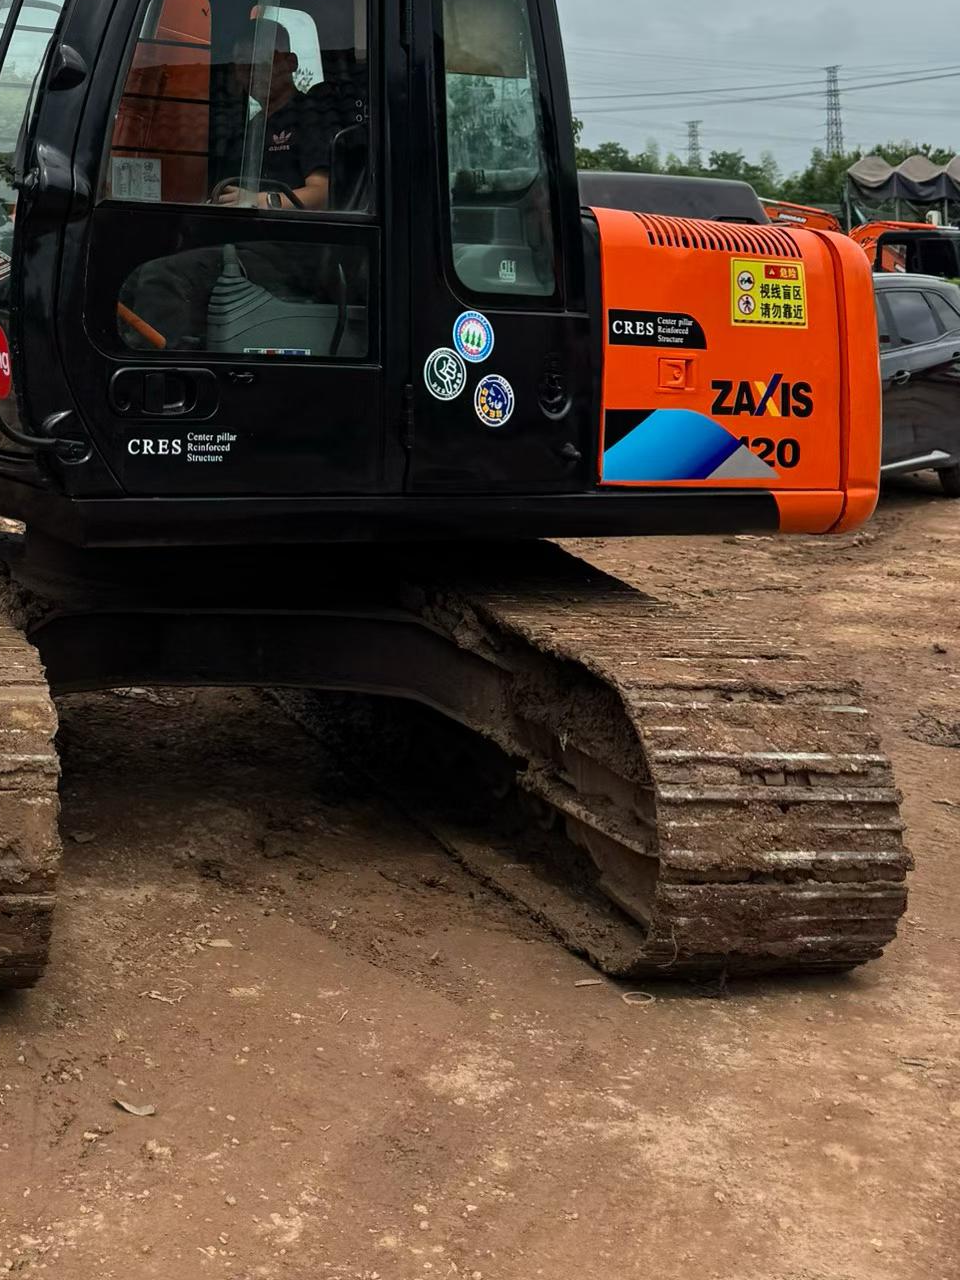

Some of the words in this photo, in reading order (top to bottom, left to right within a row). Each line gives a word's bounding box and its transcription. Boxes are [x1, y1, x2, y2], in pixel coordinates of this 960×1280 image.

[760, 283, 802, 301] 视线盲区
[760, 303, 803, 320] 请勿靠近
[612, 320, 654, 335] CRES
[657, 317, 676, 325] Center
[678, 319, 693, 327] pillar
[657, 325, 689, 335] Reinforced
[657, 334, 684, 343] Structure
[711, 373, 814, 418] ZAXIS
[187, 432, 214, 441] Center
[217, 432, 237, 443] pillar
[127, 439, 182, 455] CRES
[187, 443, 231, 451] Reinforced
[187, 453, 223, 462] Structure
